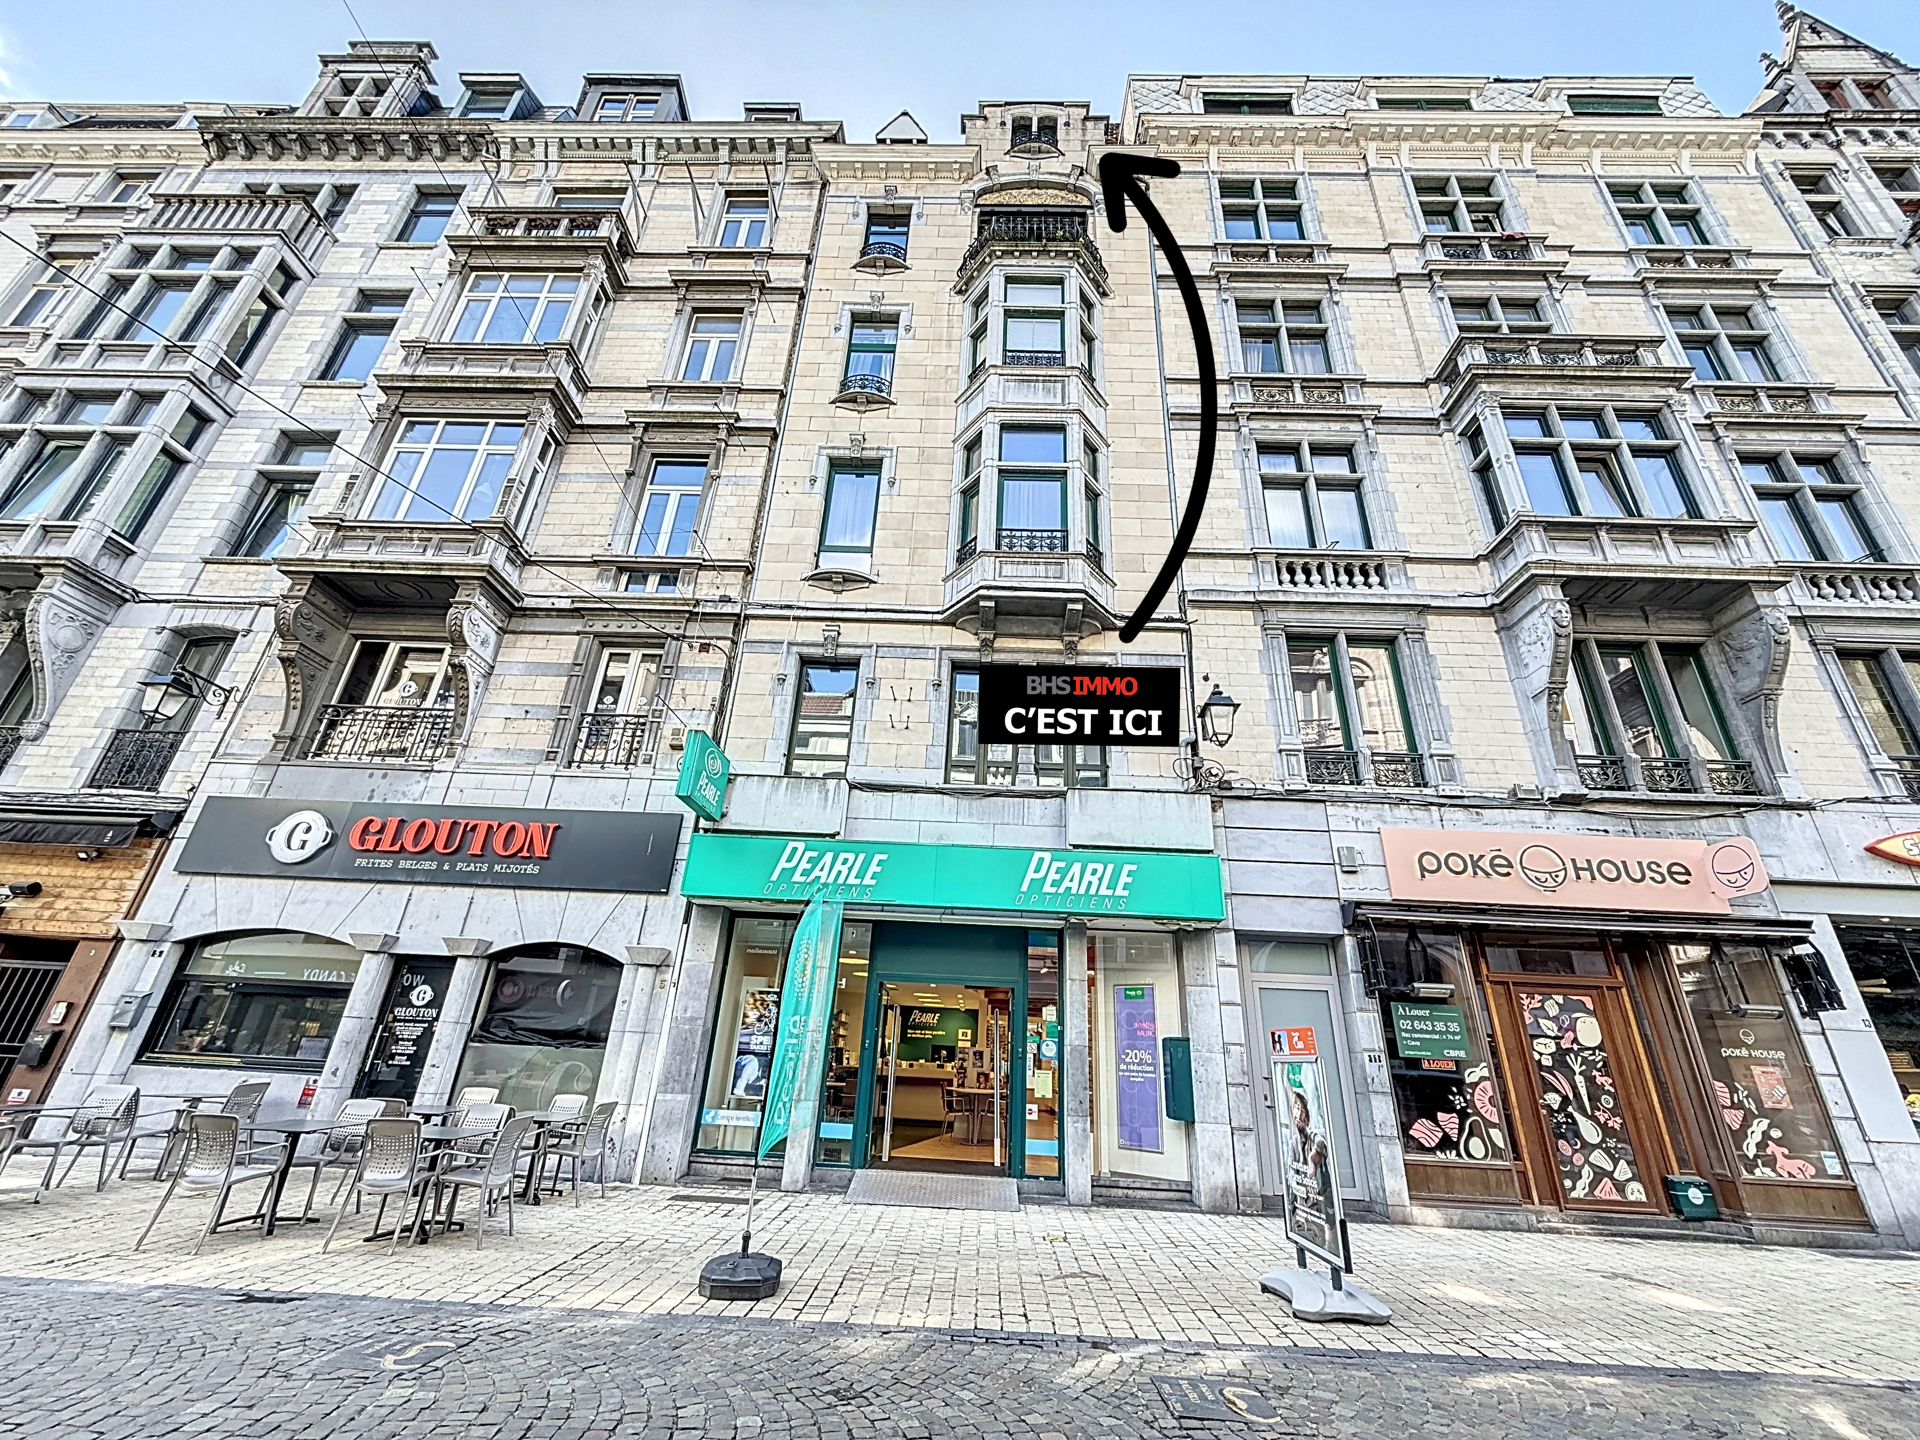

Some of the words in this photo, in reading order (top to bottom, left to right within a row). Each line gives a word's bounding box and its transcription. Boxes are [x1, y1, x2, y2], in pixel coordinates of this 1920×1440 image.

[697, 770, 721, 807] PEARLE
[349, 815, 560, 858] GLOUTON
[354, 858, 393, 868] FRITES
[398, 860, 437, 870] BELGES
[456, 862, 488, 872] PLATS
[493, 863, 540, 874] MIJOTÉS
[770, 841, 889, 886] PEARLE
[1020, 851, 1138, 897] PEARLE
[763, 882, 874, 899] OPTICIENS
[1015, 893, 1127, 910] OPTICIENS
[395, 1007, 438, 1018] GLOUTON
[910, 1010, 940, 1023] PEARLE
[1398, 1005, 1405, 1015] À
[1406, 1007, 1431, 1017] Louer
[1400, 1020, 1412, 1029] 02
[1414, 1021, 1432, 1031] 643
[1434, 1022, 1446, 1032] 35
[1447, 1023, 1460, 1032] 35
[750, 1035, 772, 1045] SPE
[1120, 1062, 1127, 1070] de
[1128, 1063, 1154, 1071] réduction
